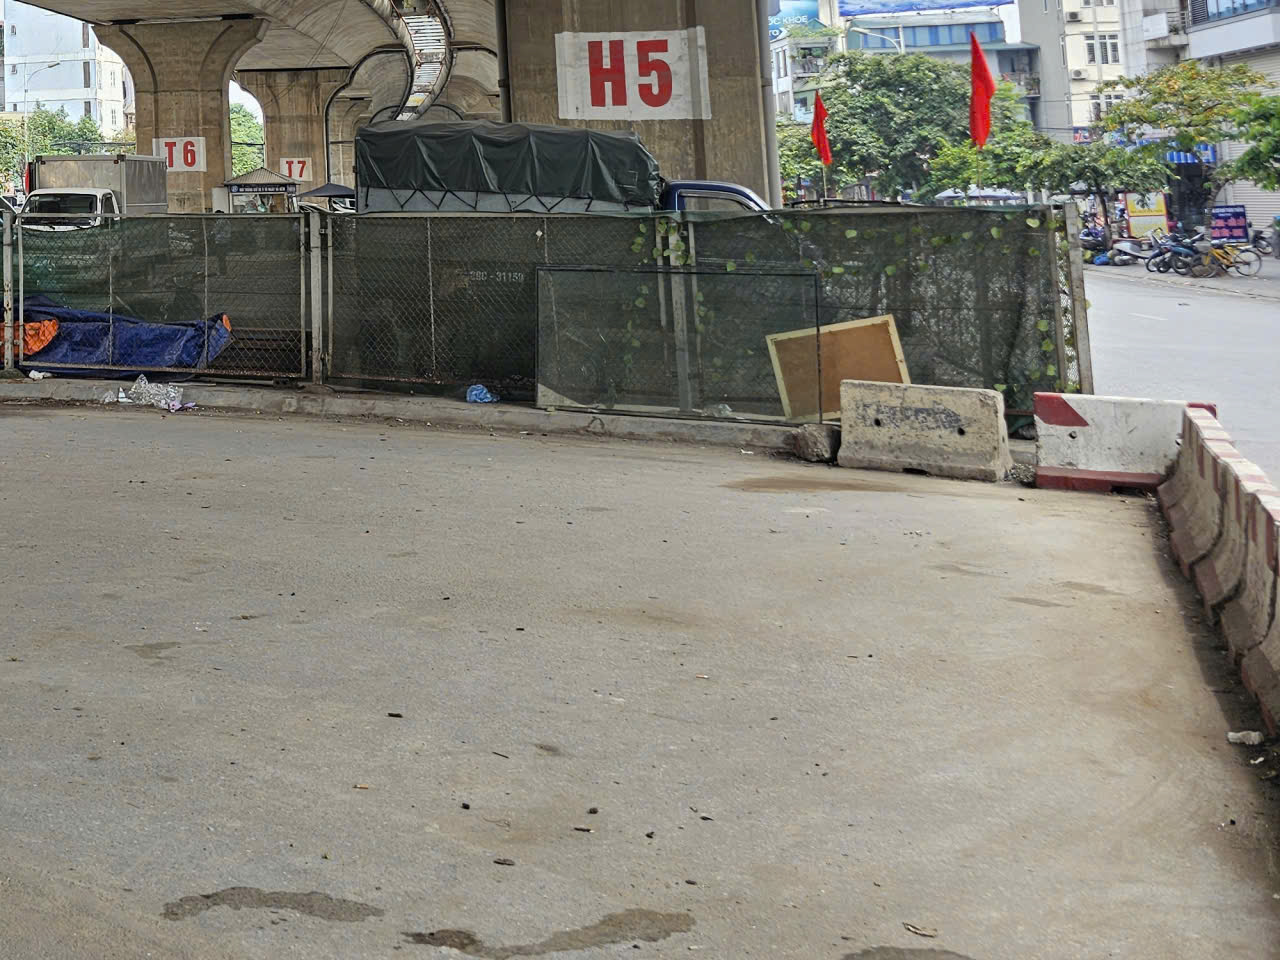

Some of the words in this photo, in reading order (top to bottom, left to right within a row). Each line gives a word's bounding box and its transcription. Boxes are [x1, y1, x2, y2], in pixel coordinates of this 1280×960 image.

[587, 39, 673, 108] H5
[164, 140, 196, 168] T6
[285, 160, 307, 178] T7
